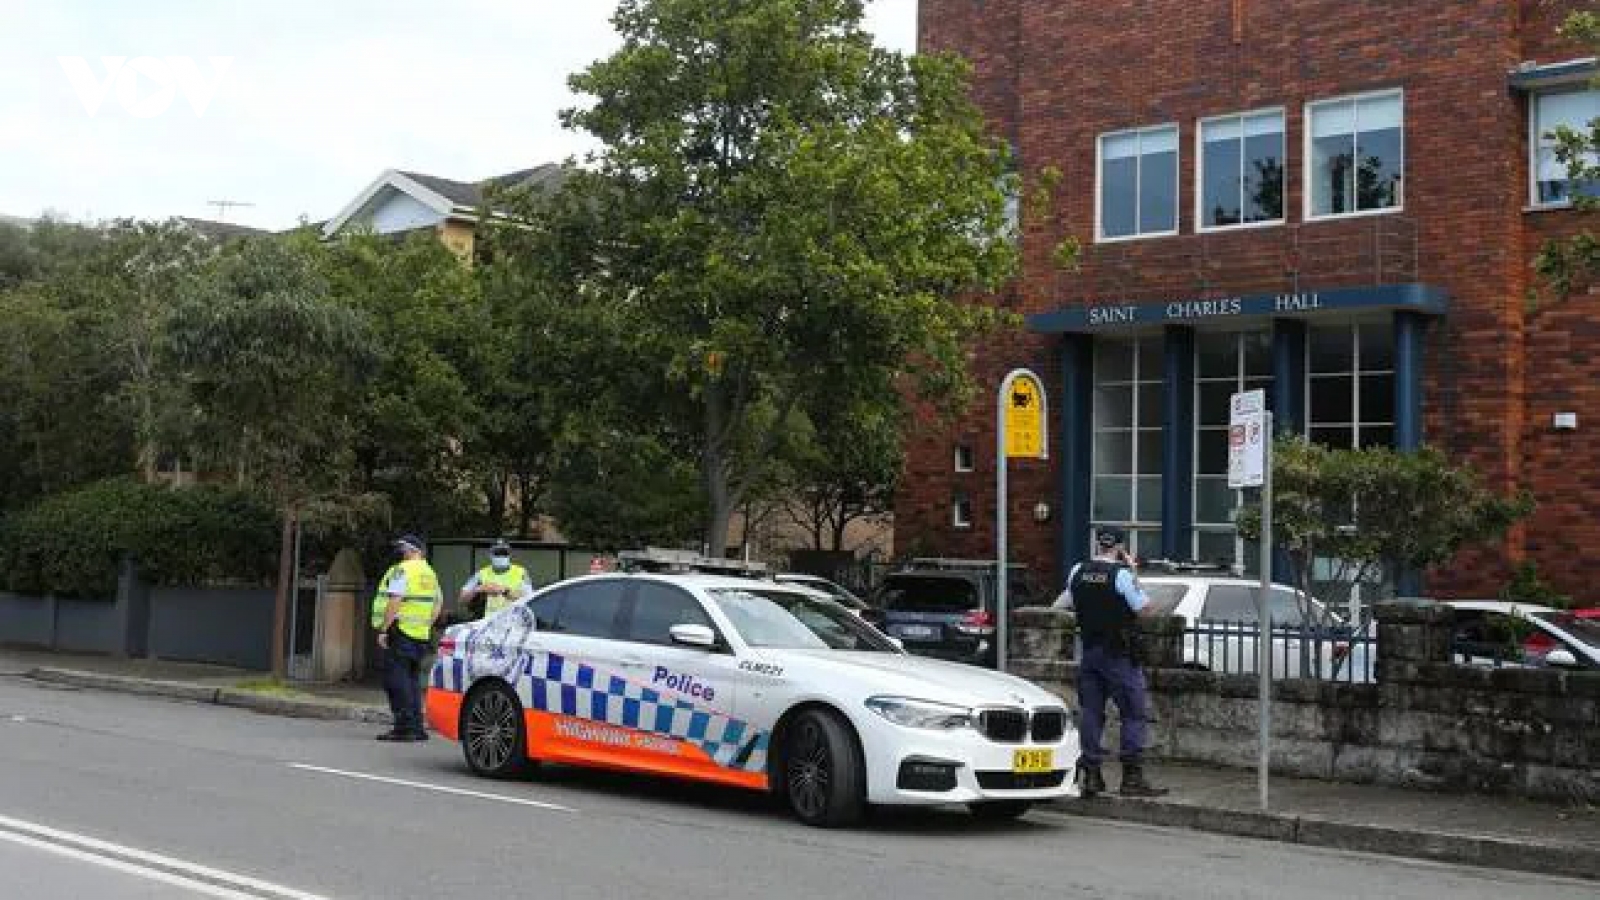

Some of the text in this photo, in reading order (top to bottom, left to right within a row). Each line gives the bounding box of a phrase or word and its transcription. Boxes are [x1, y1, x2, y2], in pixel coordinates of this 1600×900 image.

[1089, 293, 1321, 325] SAINT CHARLES HALL
[652, 665, 715, 701] Police
